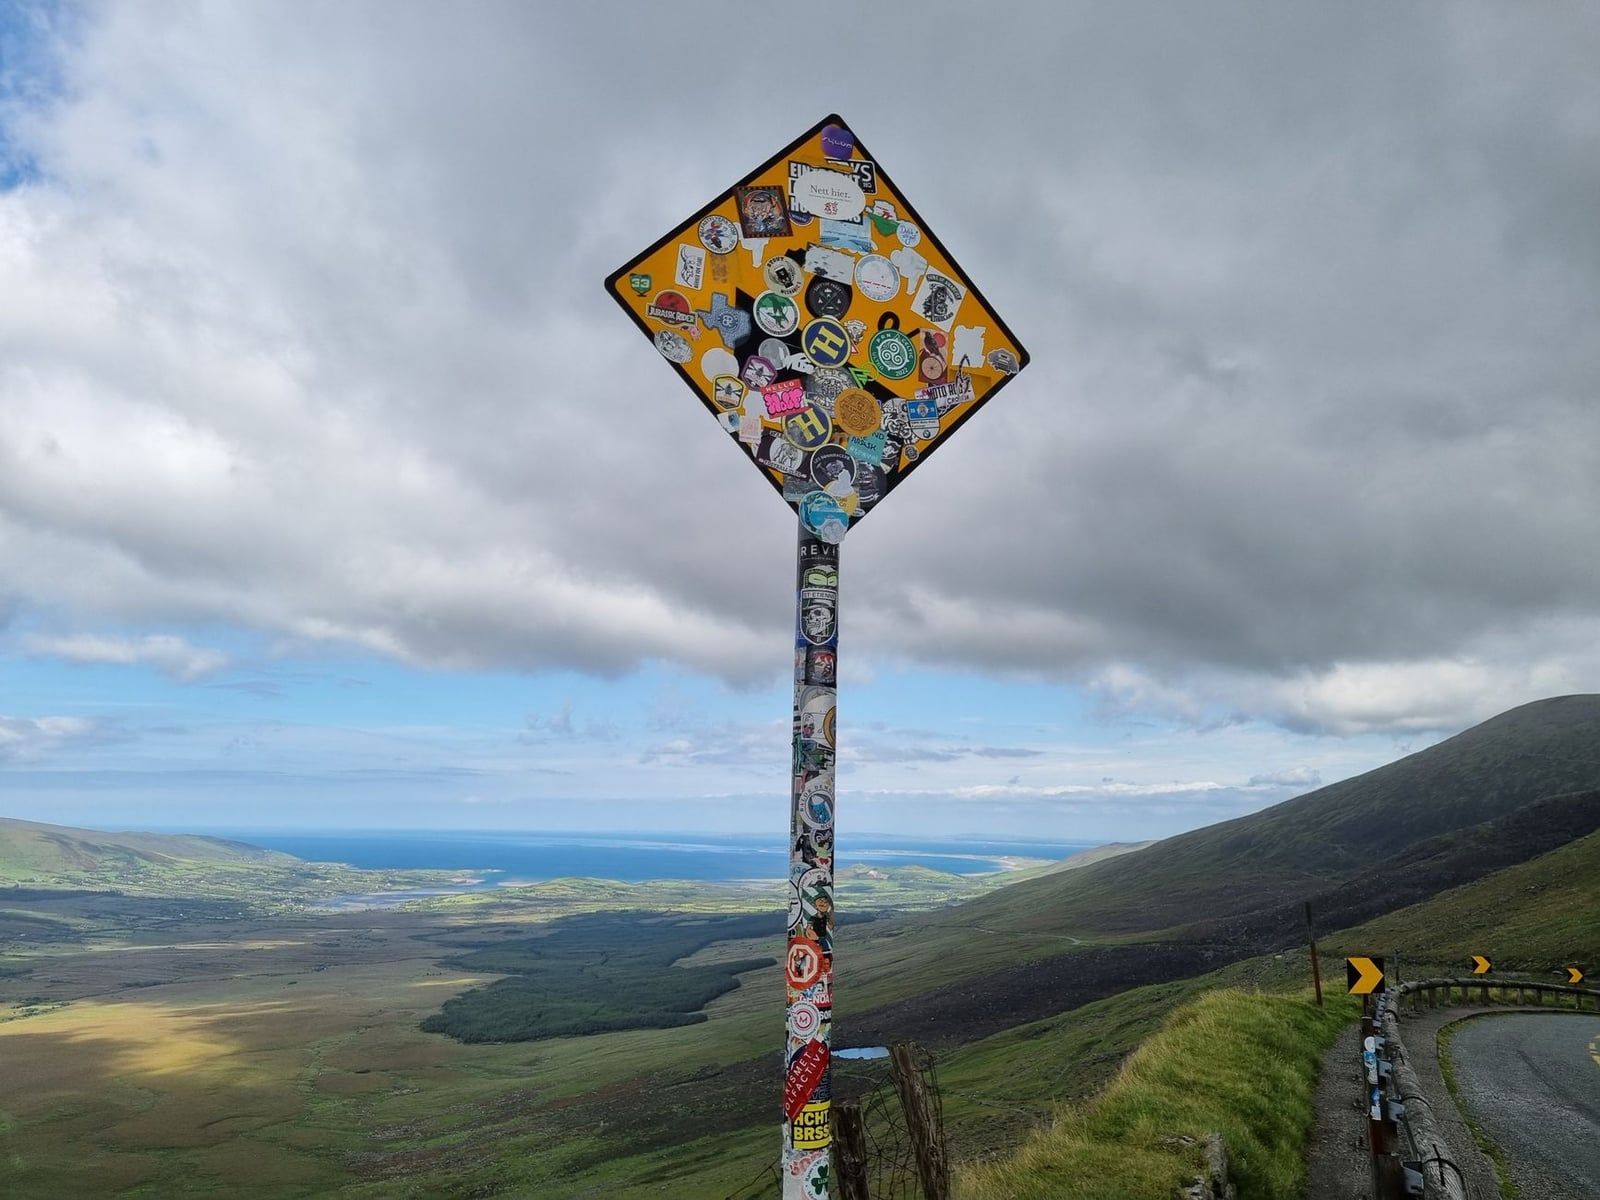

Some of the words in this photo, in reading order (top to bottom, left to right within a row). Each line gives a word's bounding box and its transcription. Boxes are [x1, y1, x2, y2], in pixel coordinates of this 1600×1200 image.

[810, 184, 829, 195] Nett
[831, 188, 851, 199] hier.
[631, 278, 650, 288] 33
[676, 312, 695, 323] RIDER
[810, 326, 845, 360] H
[902, 338, 914, 360] CELTIC
[896, 367, 909, 377] 2022
[766, 381, 795, 392] HELLO
[788, 407, 827, 443] H
[800, 544, 840, 557] REVI
[785, 1051, 811, 1095] KISMET
[785, 1046, 826, 1111] OLFACTIVE
[793, 1124, 830, 1140] BRSS
